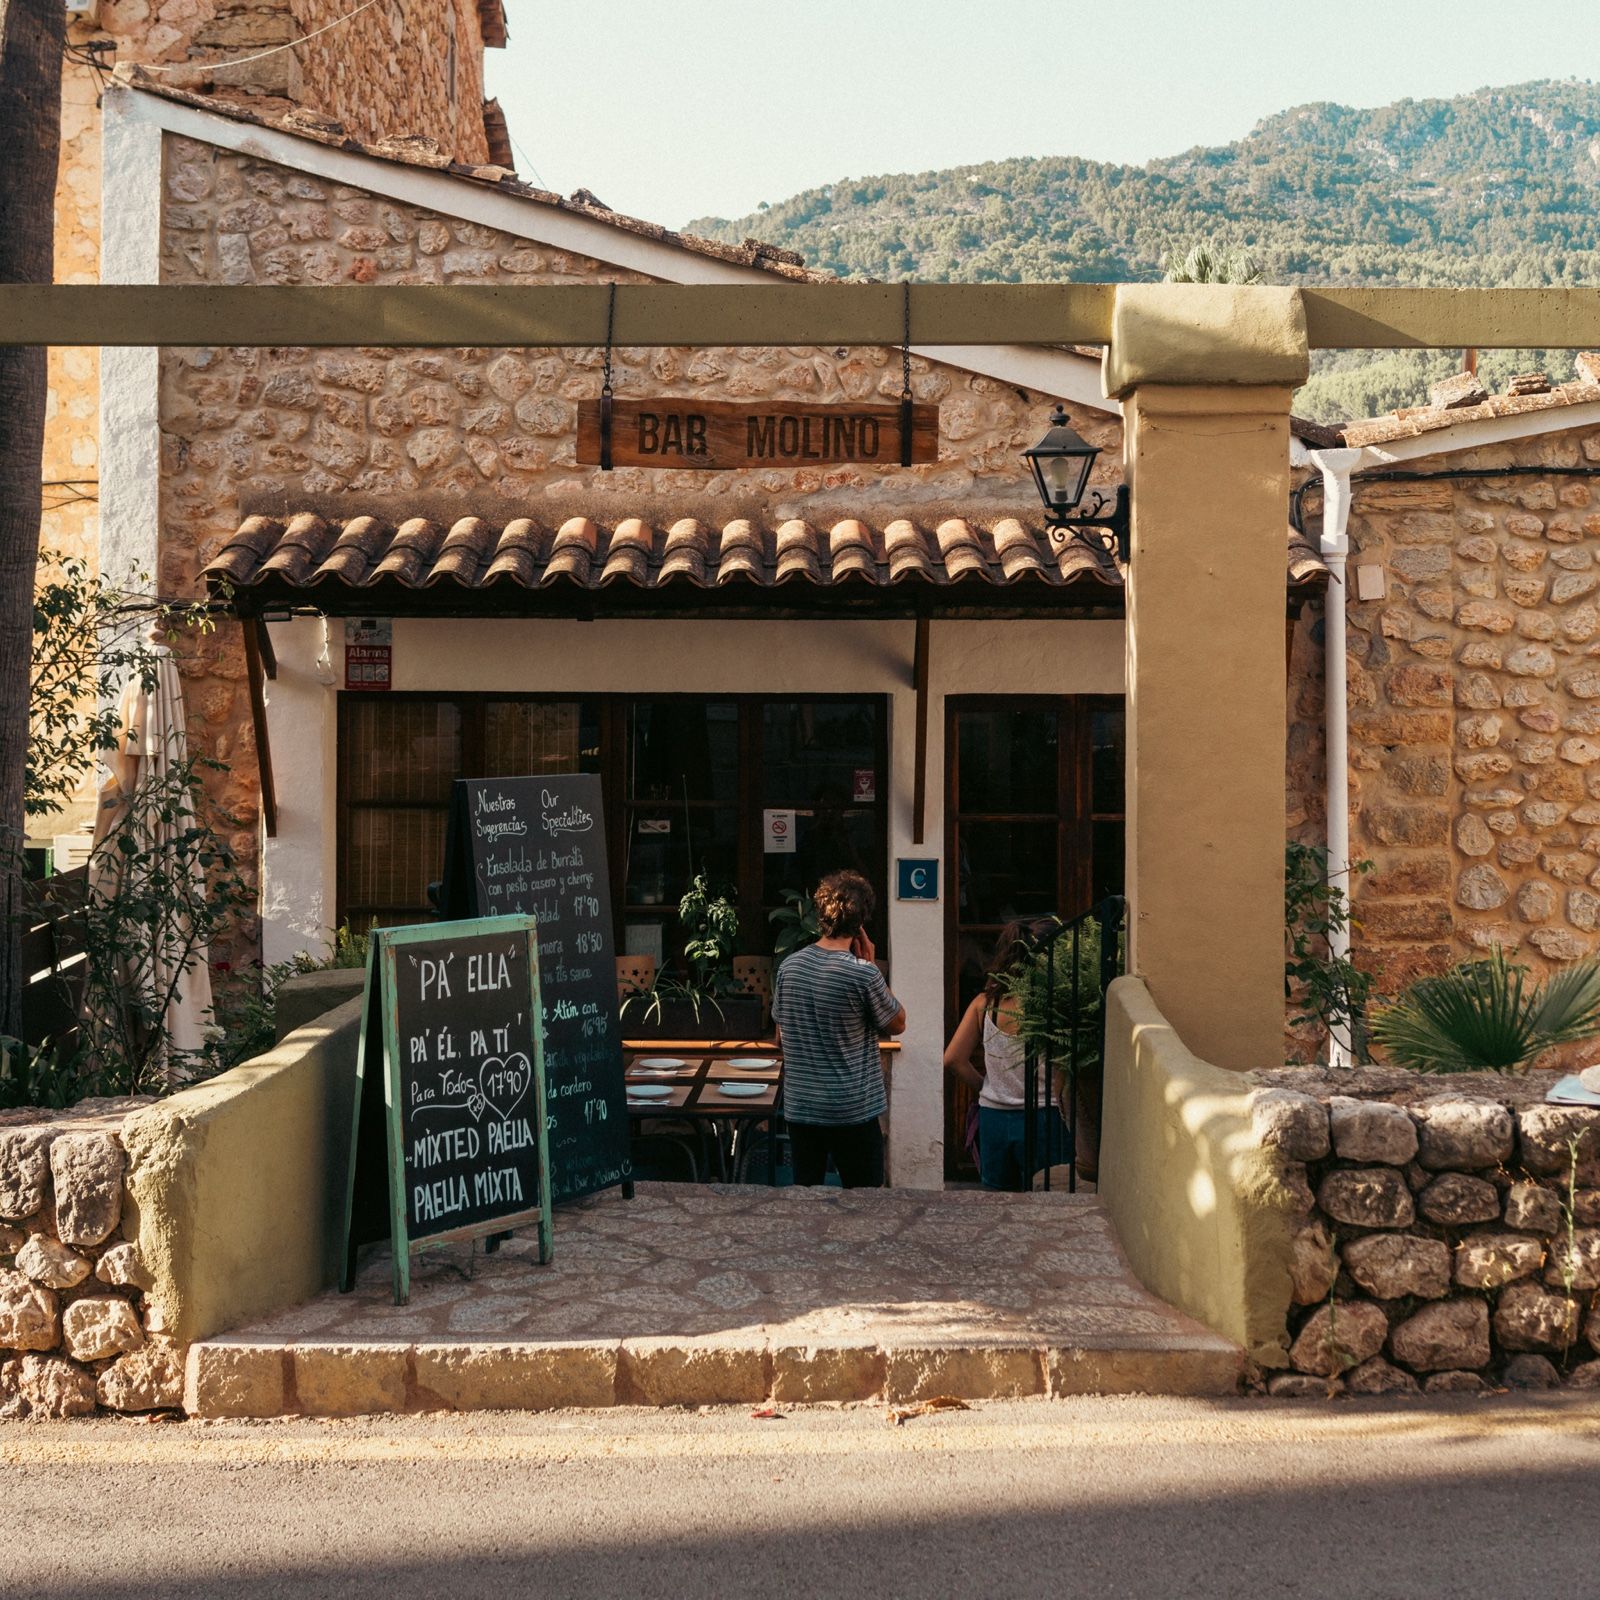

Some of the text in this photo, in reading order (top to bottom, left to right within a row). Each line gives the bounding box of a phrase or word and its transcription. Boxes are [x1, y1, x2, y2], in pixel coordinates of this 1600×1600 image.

[637, 413, 880, 459] BAR MOLINO
[348, 647, 389, 657] Alarma
[474, 788, 516, 816] Nuestras
[541, 789, 560, 809] Our
[476, 816, 527, 842] Sugerencias
[541, 805, 593, 837] Specialties
[486, 845, 584, 877] Ensalada de Burrata
[488, 884, 503, 896] con
[506, 874, 528, 900] pesto
[531, 877, 556, 891] casero
[559, 877, 566, 895] y
[573, 894, 599, 917] 17'90
[575, 930, 603, 955] 18'50
[581, 1002, 599, 1015] con
[411, 1081, 435, 1106] Para
[560, 1075, 592, 1097] cordero
[488, 1118, 535, 1155] PAELLA
[414, 1175, 471, 1223] PAELLA
